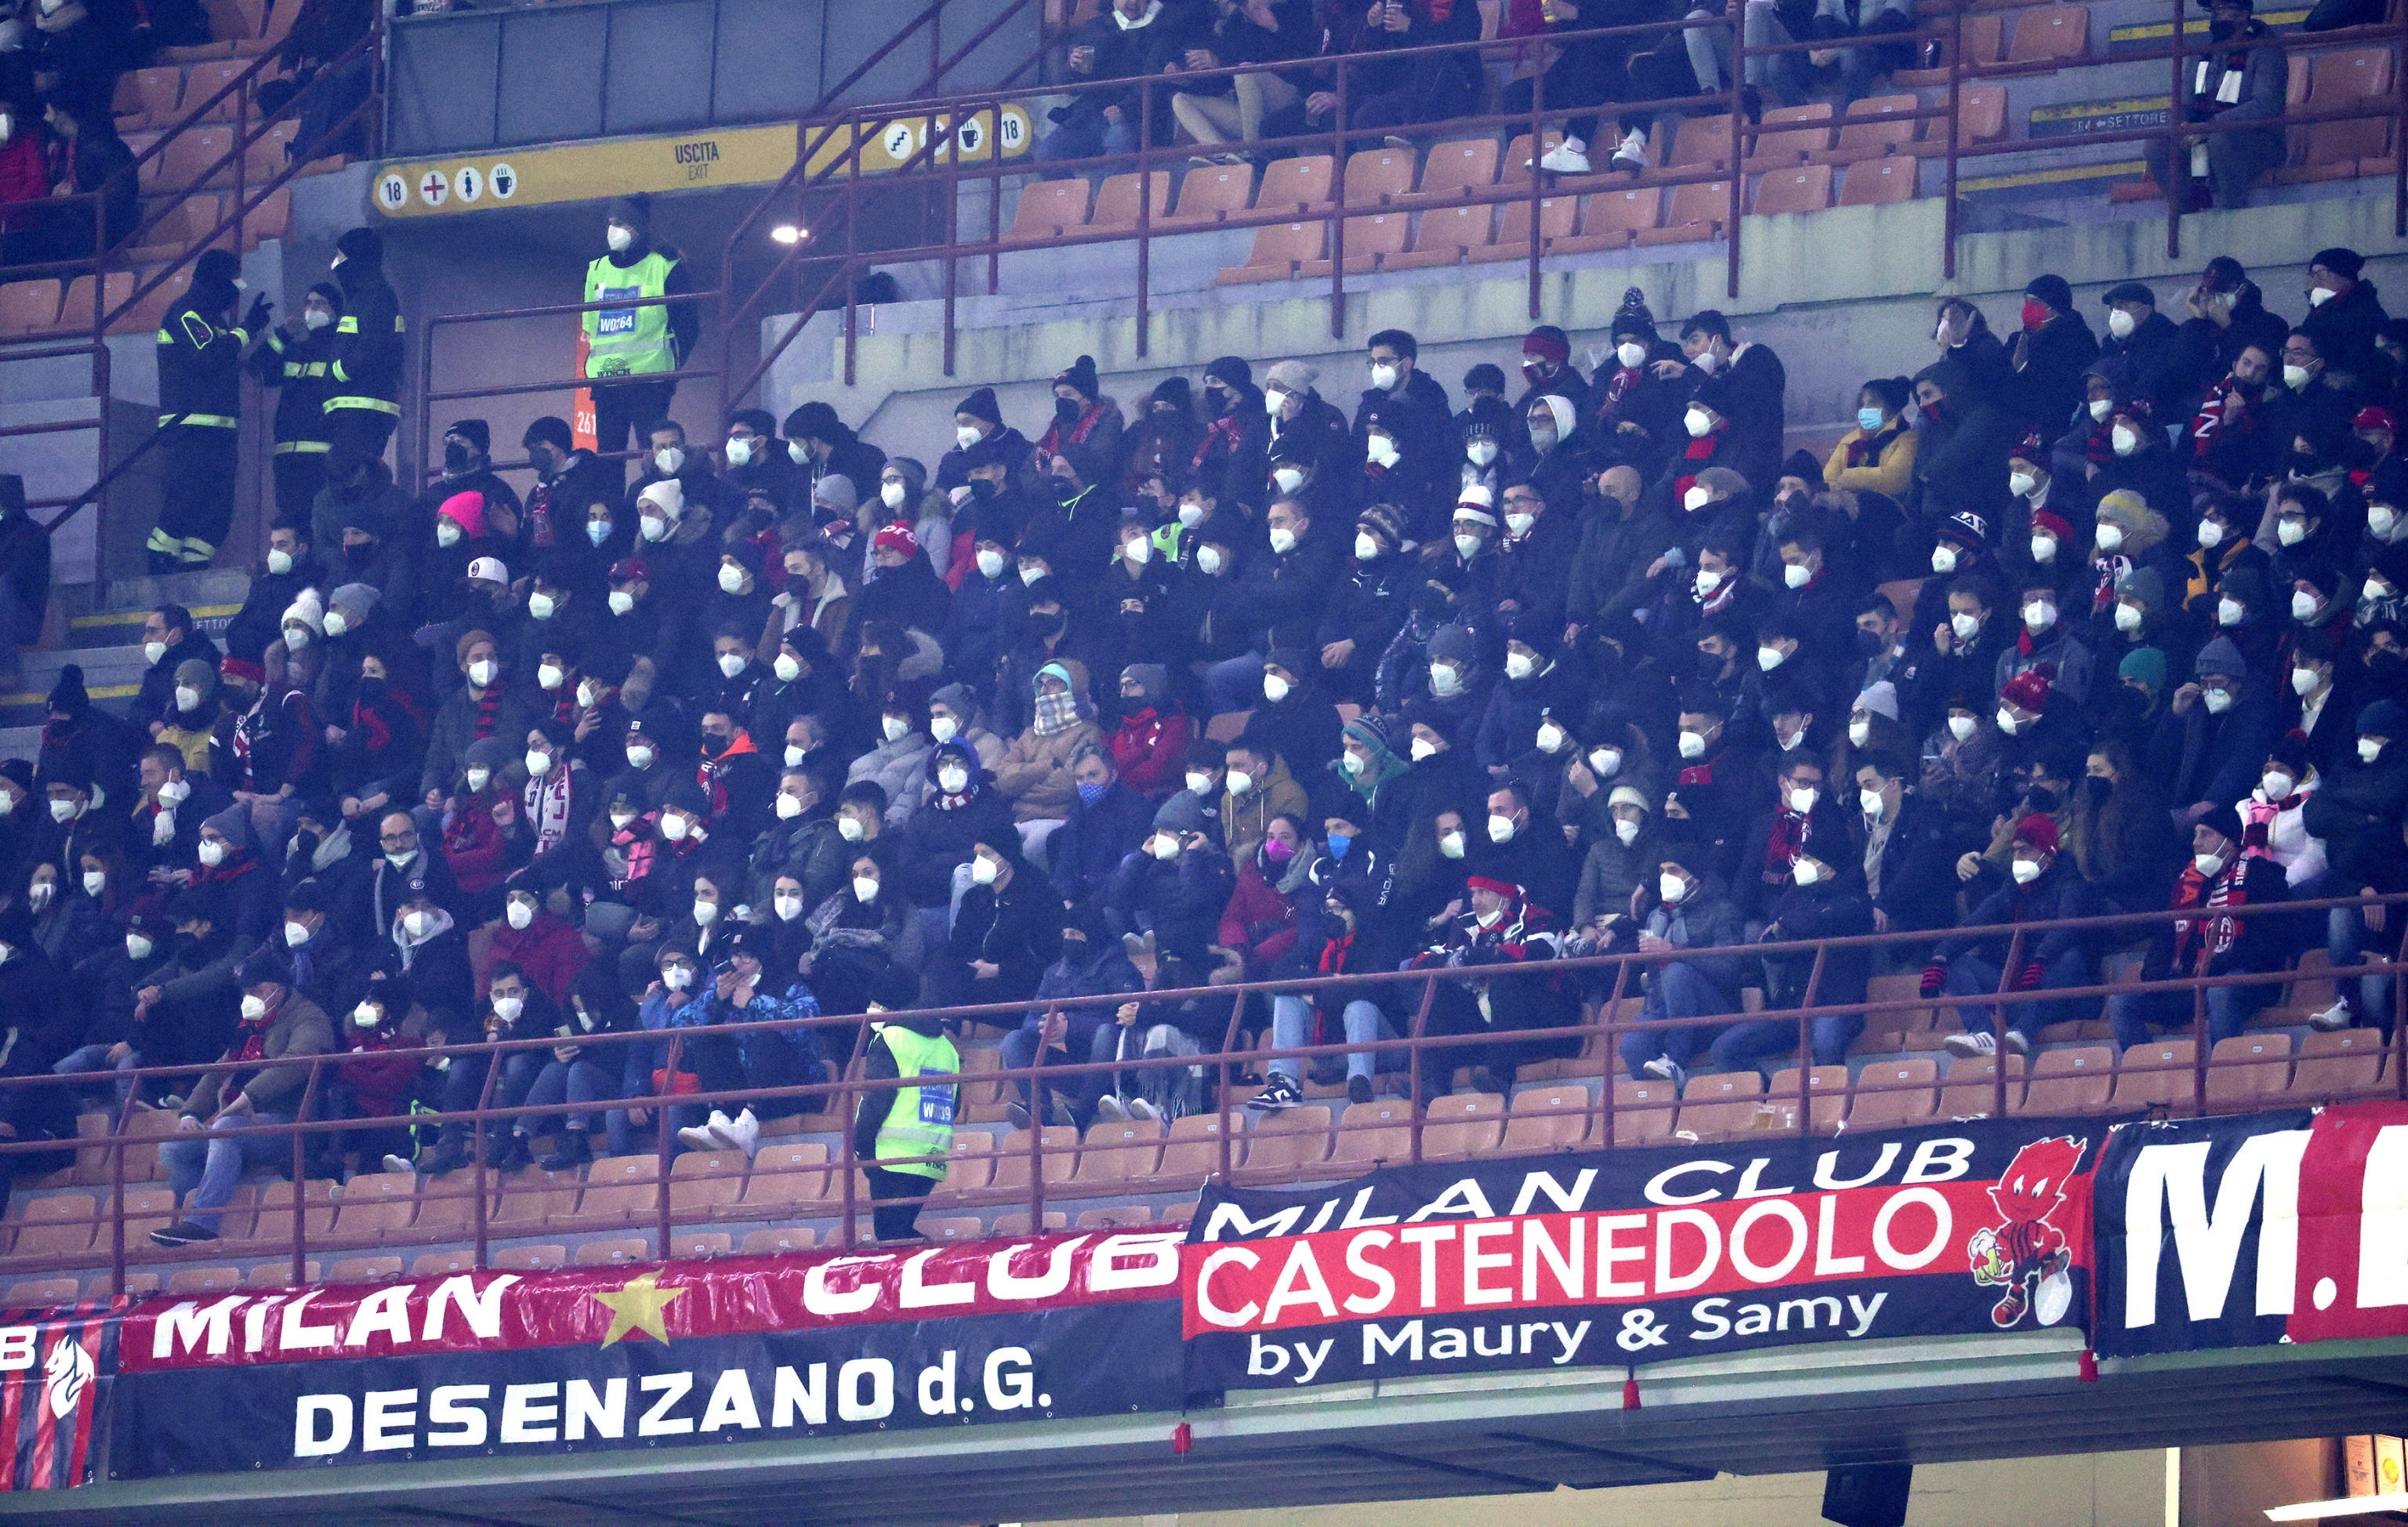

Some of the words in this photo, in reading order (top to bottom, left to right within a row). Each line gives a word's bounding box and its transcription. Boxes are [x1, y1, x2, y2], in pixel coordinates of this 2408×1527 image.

[675, 140, 720, 165] USCITA
[1003, 119, 1018, 140] 18
[385, 180, 401, 202] 18
[688, 163, 709, 181] EXIT
[577, 411, 596, 436] 261
[1203, 1168, 1599, 1242] MILAN
[1644, 1137, 1976, 1206] CLUB
[1197, 1187, 1953, 1328] CASTENEDOLO
[152, 1274, 524, 1358] MILAN
[803, 1231, 1188, 1315] CLUB
[1246, 1333, 1335, 1384] by
[1362, 1319, 1592, 1365] Maury
[1616, 1308, 1670, 1351] &
[1688, 1293, 1888, 1338] Samy
[294, 1358, 895, 1457] DESENZANO
